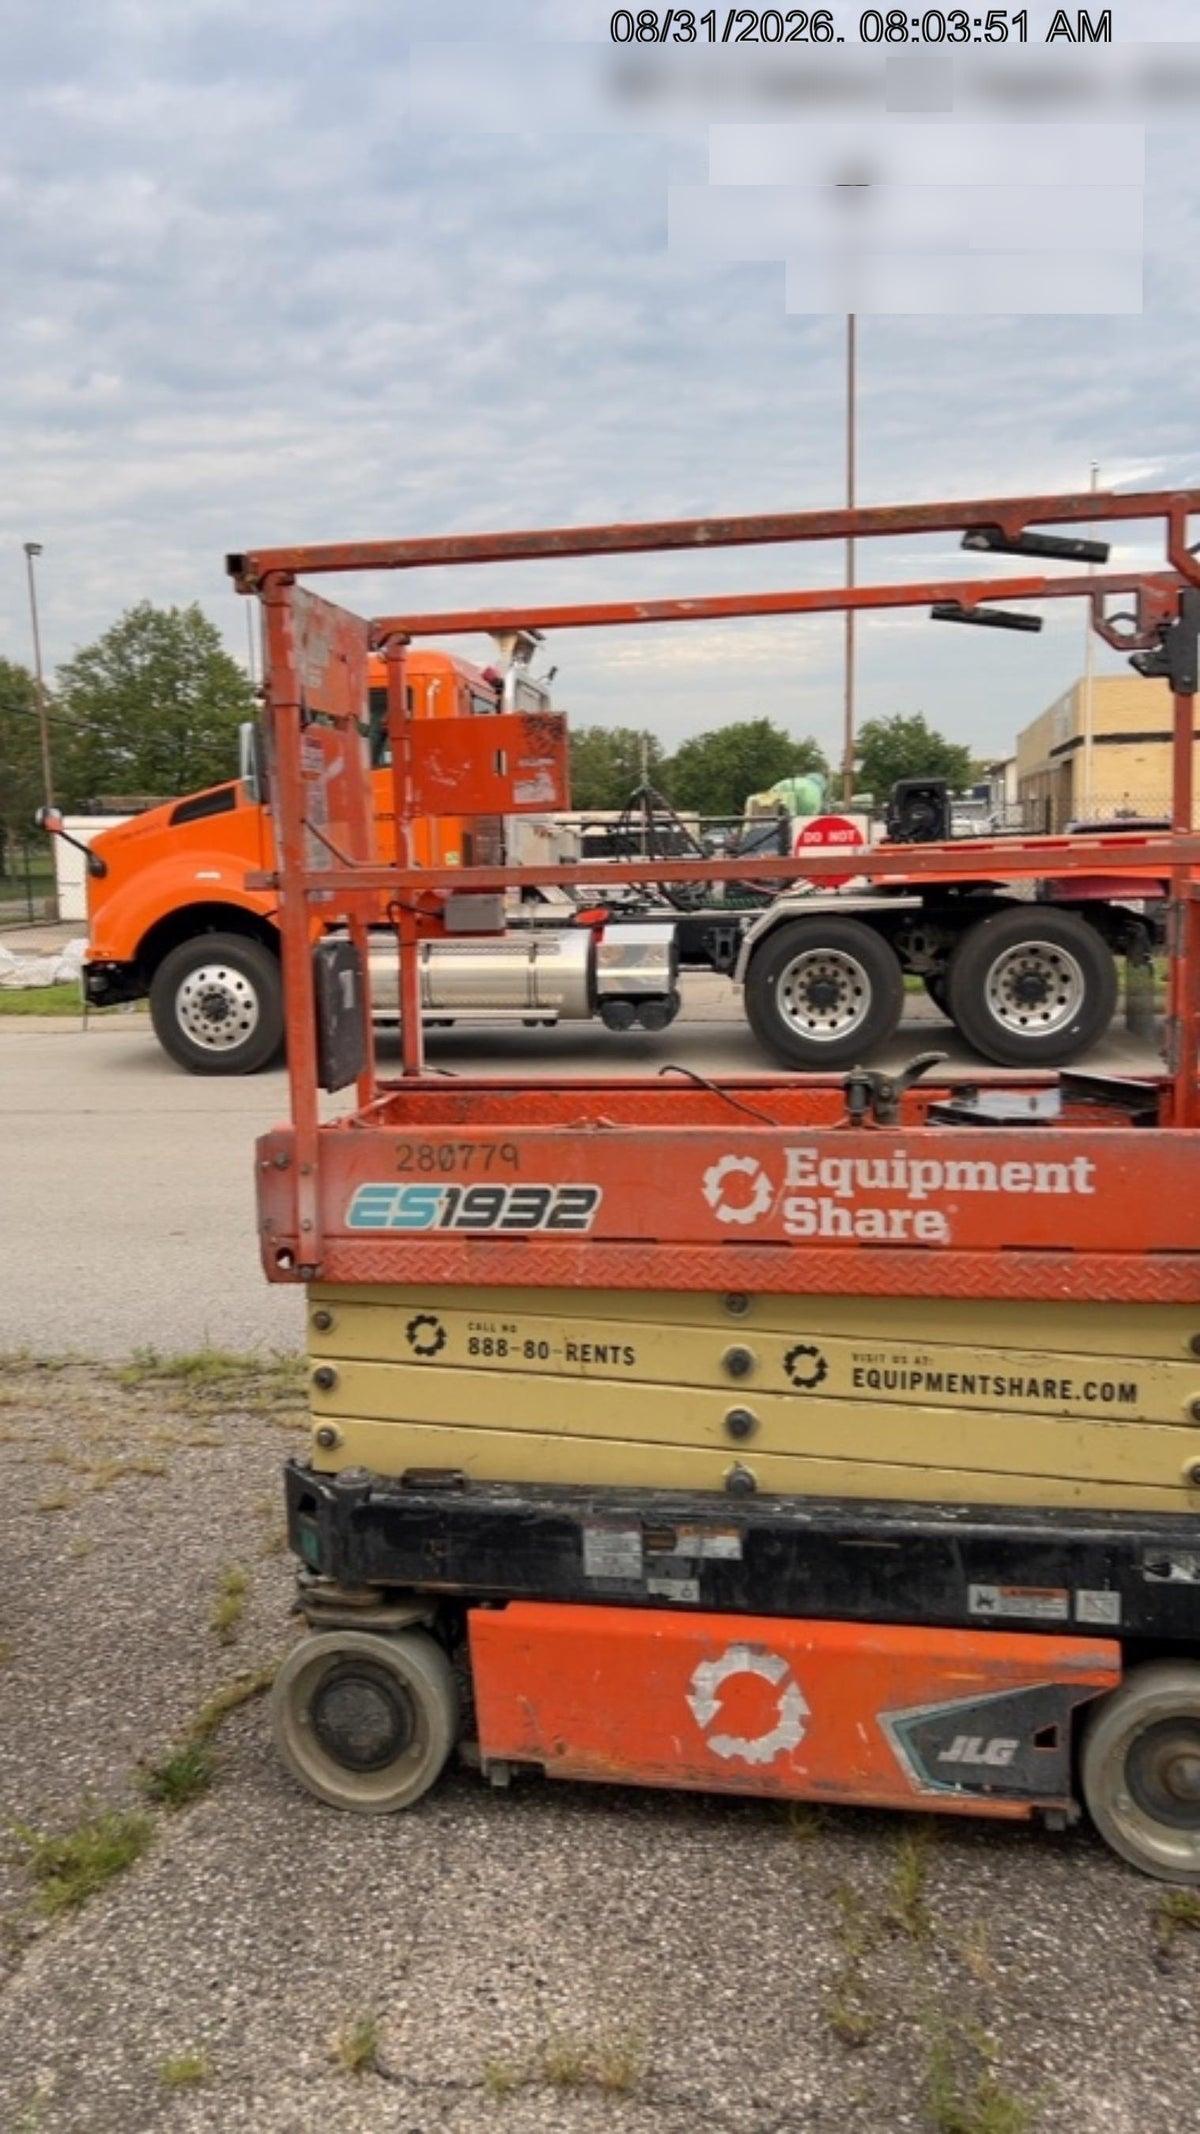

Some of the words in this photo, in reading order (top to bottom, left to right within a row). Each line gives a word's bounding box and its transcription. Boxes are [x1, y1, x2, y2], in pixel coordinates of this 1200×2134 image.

[803, 831, 823, 843] DO
[828, 829, 855, 842] NOT
[396, 1143, 520, 1172] 280779
[784, 1147, 1096, 1199] Equipment
[347, 1184, 601, 1231] ES1932
[784, 1196, 950, 1242] Share
[467, 1321, 497, 1333] CALL
[468, 1336, 636, 1367] 888-80-RENTS
[852, 1367, 1138, 1404] EQUIPMENTSHARE.COM
[937, 1735, 1021, 1767] JLG
